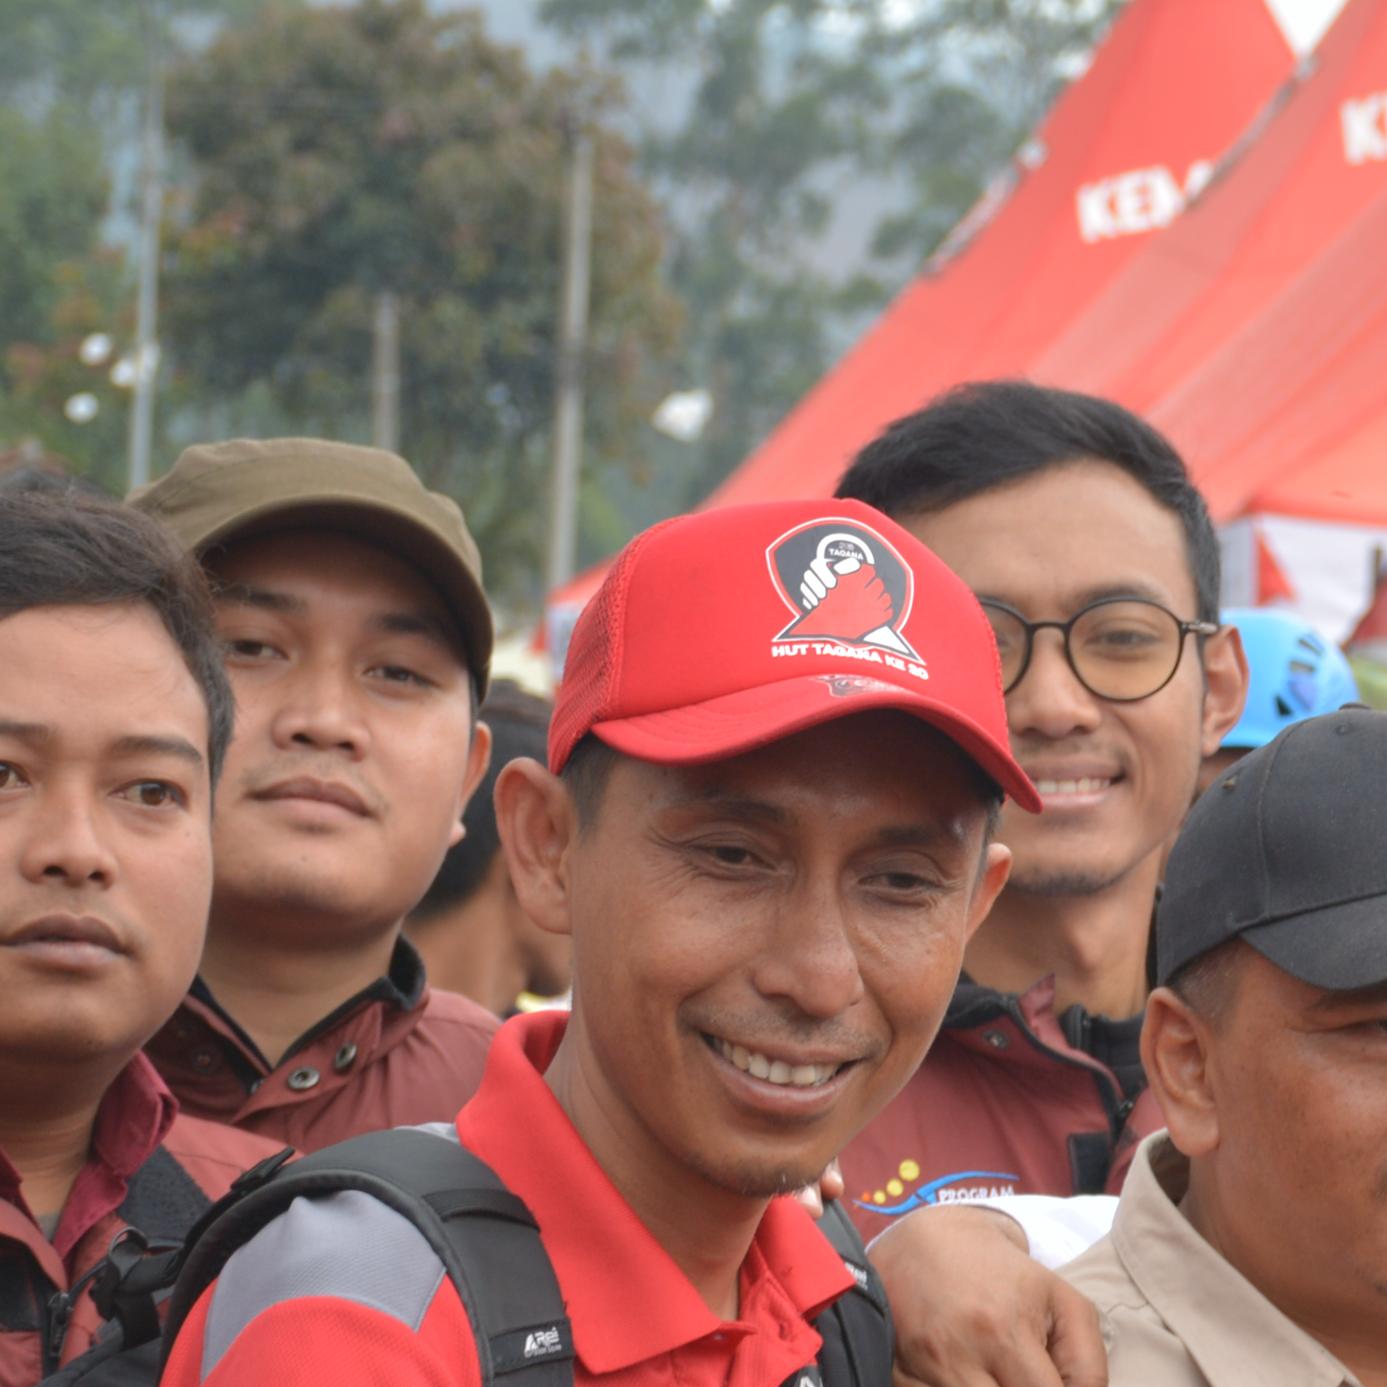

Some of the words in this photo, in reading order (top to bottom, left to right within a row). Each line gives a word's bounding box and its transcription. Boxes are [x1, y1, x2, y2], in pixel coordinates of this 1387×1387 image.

[772, 644, 809, 657] HUT
[812, 644, 882, 664] TAGANA
[938, 1185, 1016, 1203] PROGRAM
